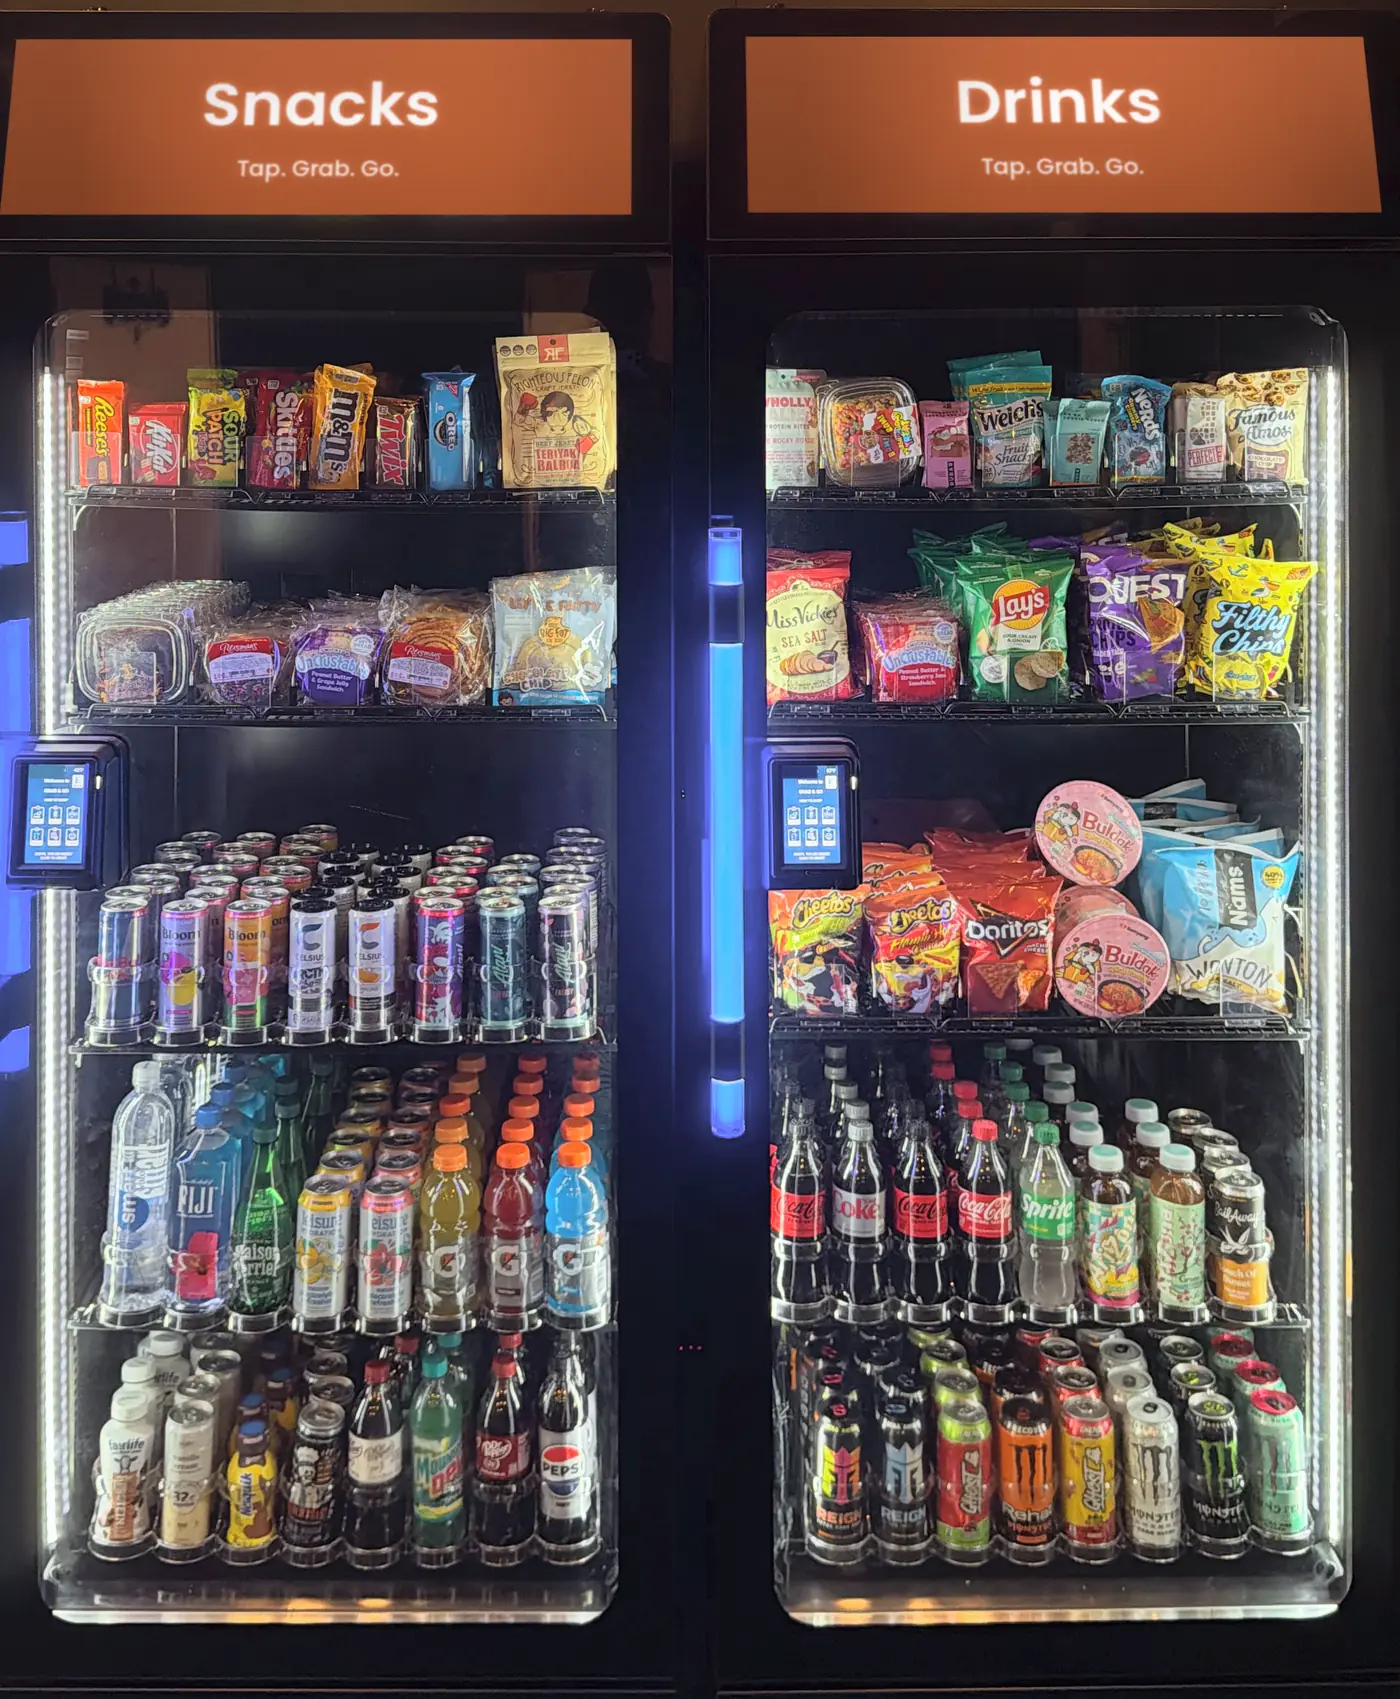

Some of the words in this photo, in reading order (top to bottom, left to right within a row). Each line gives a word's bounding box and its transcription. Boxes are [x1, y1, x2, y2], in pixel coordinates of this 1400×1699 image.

[204, 81, 439, 127] Snacks
[957, 77, 1160, 124] Drinks
[238, 161, 286, 182] Tap.
[292, 161, 355, 177] Grab.
[361, 161, 400, 177] Go.
[981, 158, 1032, 180] Tap.
[1037, 158, 1100, 175] Grab.
[1107, 158, 1145, 175] Go.
[515, 372, 569, 392] RIGHTEOUS
[567, 372, 595, 389] FELON
[94, 396, 116, 456] Reese's
[977, 399, 1044, 432] Welch's
[1228, 404, 1297, 431] Famous
[206, 408, 225, 465] PATCH
[222, 411, 240, 464] SOUR
[275, 391, 299, 480] Skittles
[444, 411, 457, 452] OREO
[1245, 425, 1290, 441] Amos
[382, 414, 407, 484] Twix
[995, 451, 1031, 466] Snack
[1004, 443, 1030, 455] Fruit
[1187, 447, 1218, 467] PERFECT
[537, 459, 580, 472] BALBOA
[1088, 573, 1187, 605] QUEST
[998, 588, 1045, 622] Lay's
[1212, 601, 1291, 638] Filthy
[782, 635, 803, 648] SEA
[804, 629, 828, 645] SALT
[1092, 632, 1137, 648] CHIPS
[1212, 631, 1286, 656] Chips
[882, 648, 958, 672] Uncrustables
[332, 673, 353, 681] Butter
[519, 679, 552, 692] CHIP
[1082, 810, 1136, 859] Buldak
[792, 891, 855, 930] Cheetos
[888, 899, 952, 935] Cheetos
[162, 927, 201, 941] Bloom
[228, 927, 267, 941] Bloom
[967, 918, 1050, 941] Doritos
[1103, 943, 1161, 982] Buldak
[177, 1188, 215, 1214] FIJI
[833, 1191, 881, 1221] Coke
[1020, 1195, 1073, 1220] Sprite
[109, 1438, 145, 1453] fairlife
